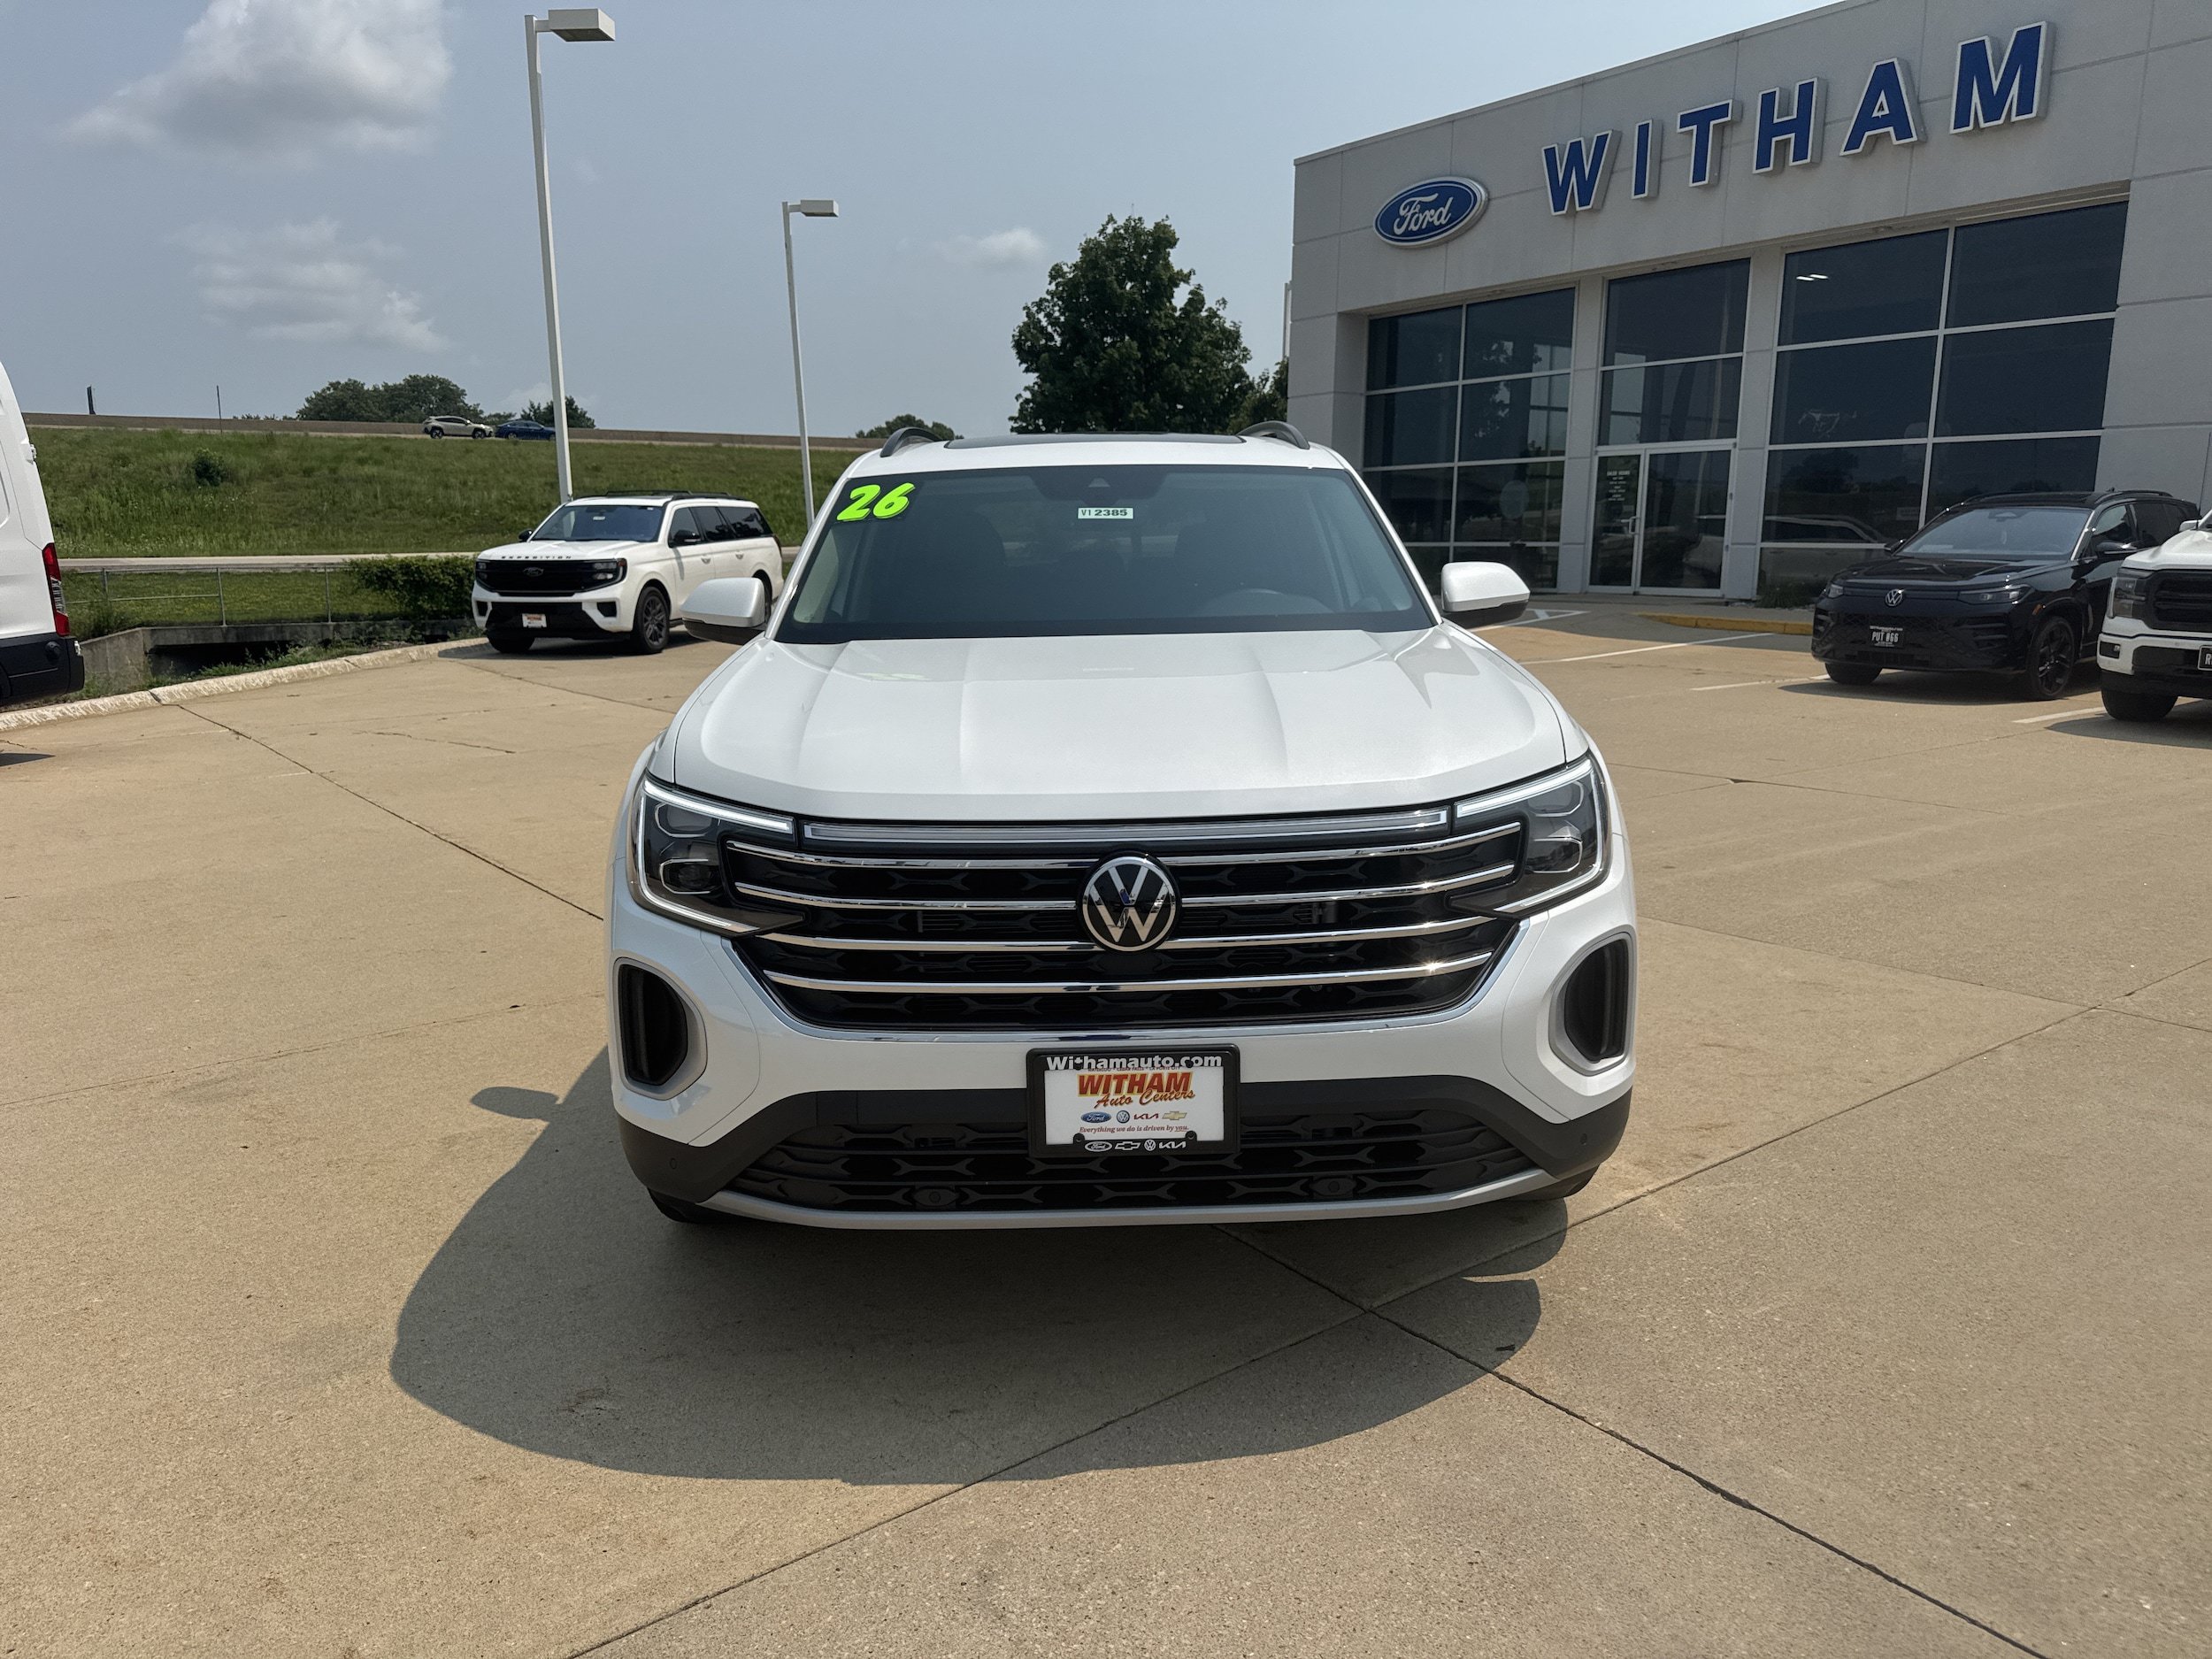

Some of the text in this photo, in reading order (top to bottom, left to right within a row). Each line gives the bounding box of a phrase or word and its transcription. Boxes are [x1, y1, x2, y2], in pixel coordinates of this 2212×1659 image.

[1541, 20, 2051, 216] WITHAM
[1394, 193, 1454, 235] Ford
[836, 482, 915, 521] 26
[1046, 1055, 1222, 1071] Withamauto.com
[1079, 1071, 1192, 1095] WITHAM
[1094, 1087, 1195, 1109] Auto Centers
[1086, 1113, 1108, 1122] Ford
